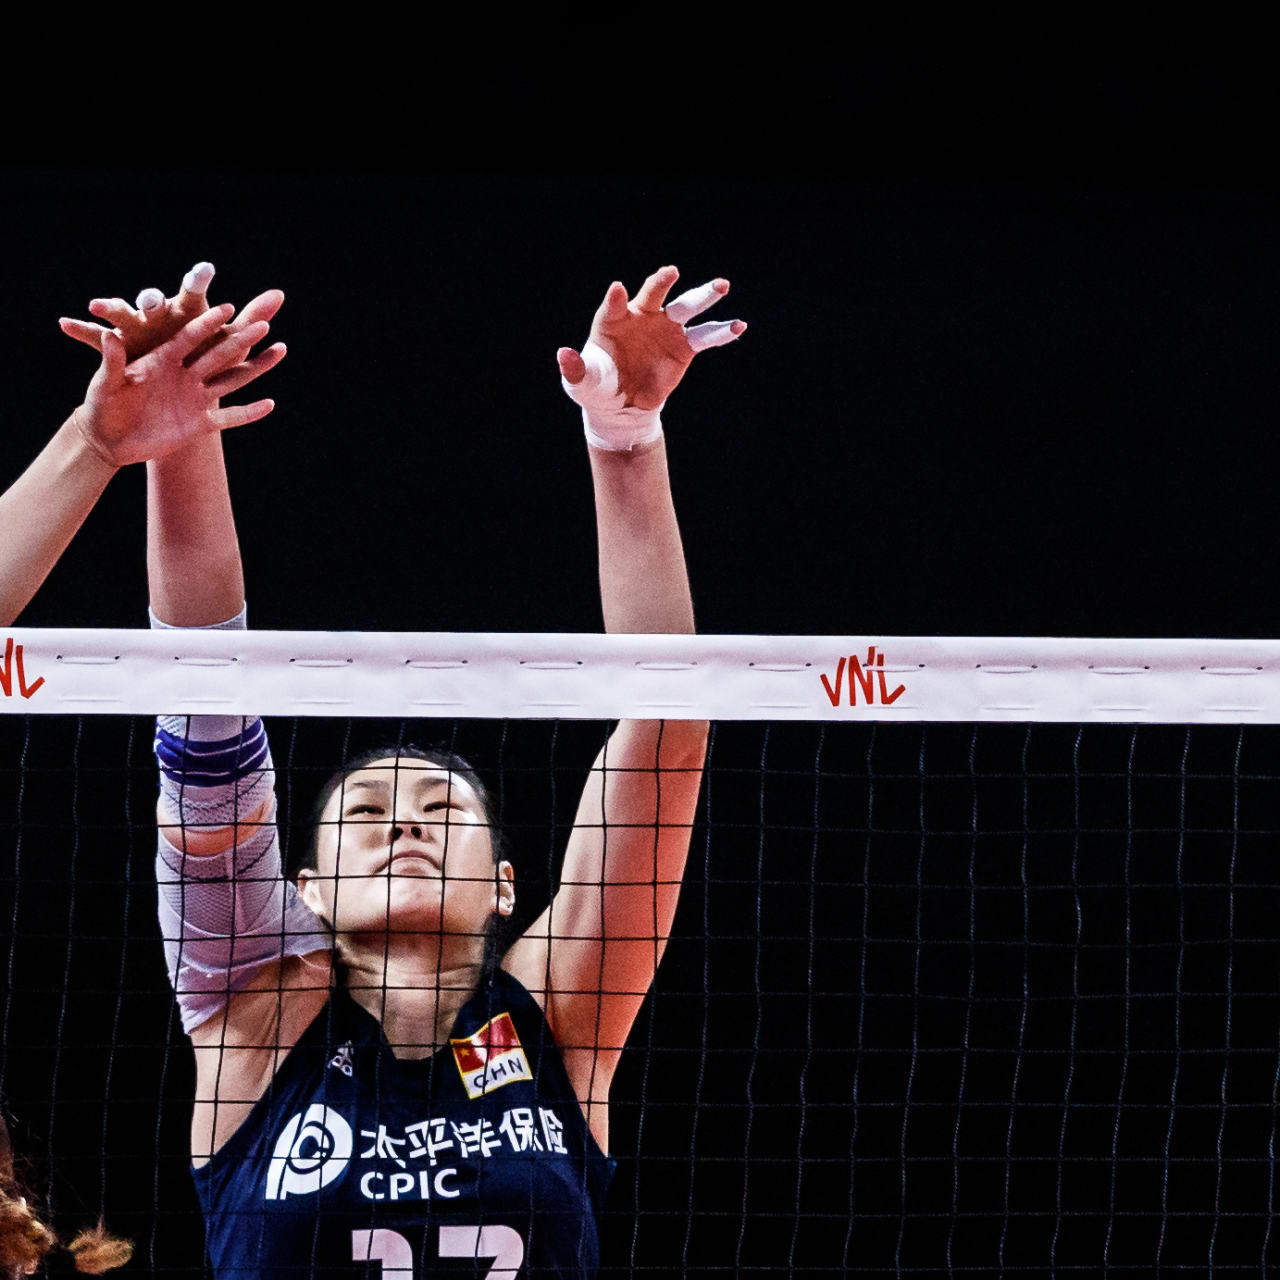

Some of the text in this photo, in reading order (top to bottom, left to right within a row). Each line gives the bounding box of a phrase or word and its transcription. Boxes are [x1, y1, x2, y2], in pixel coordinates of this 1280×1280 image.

[820, 645, 905, 706] VNL
[473, 1056, 524, 1089] CHN
[360, 1106, 568, 1168] 太平洋保险
[360, 1168, 461, 1200] CPIC
